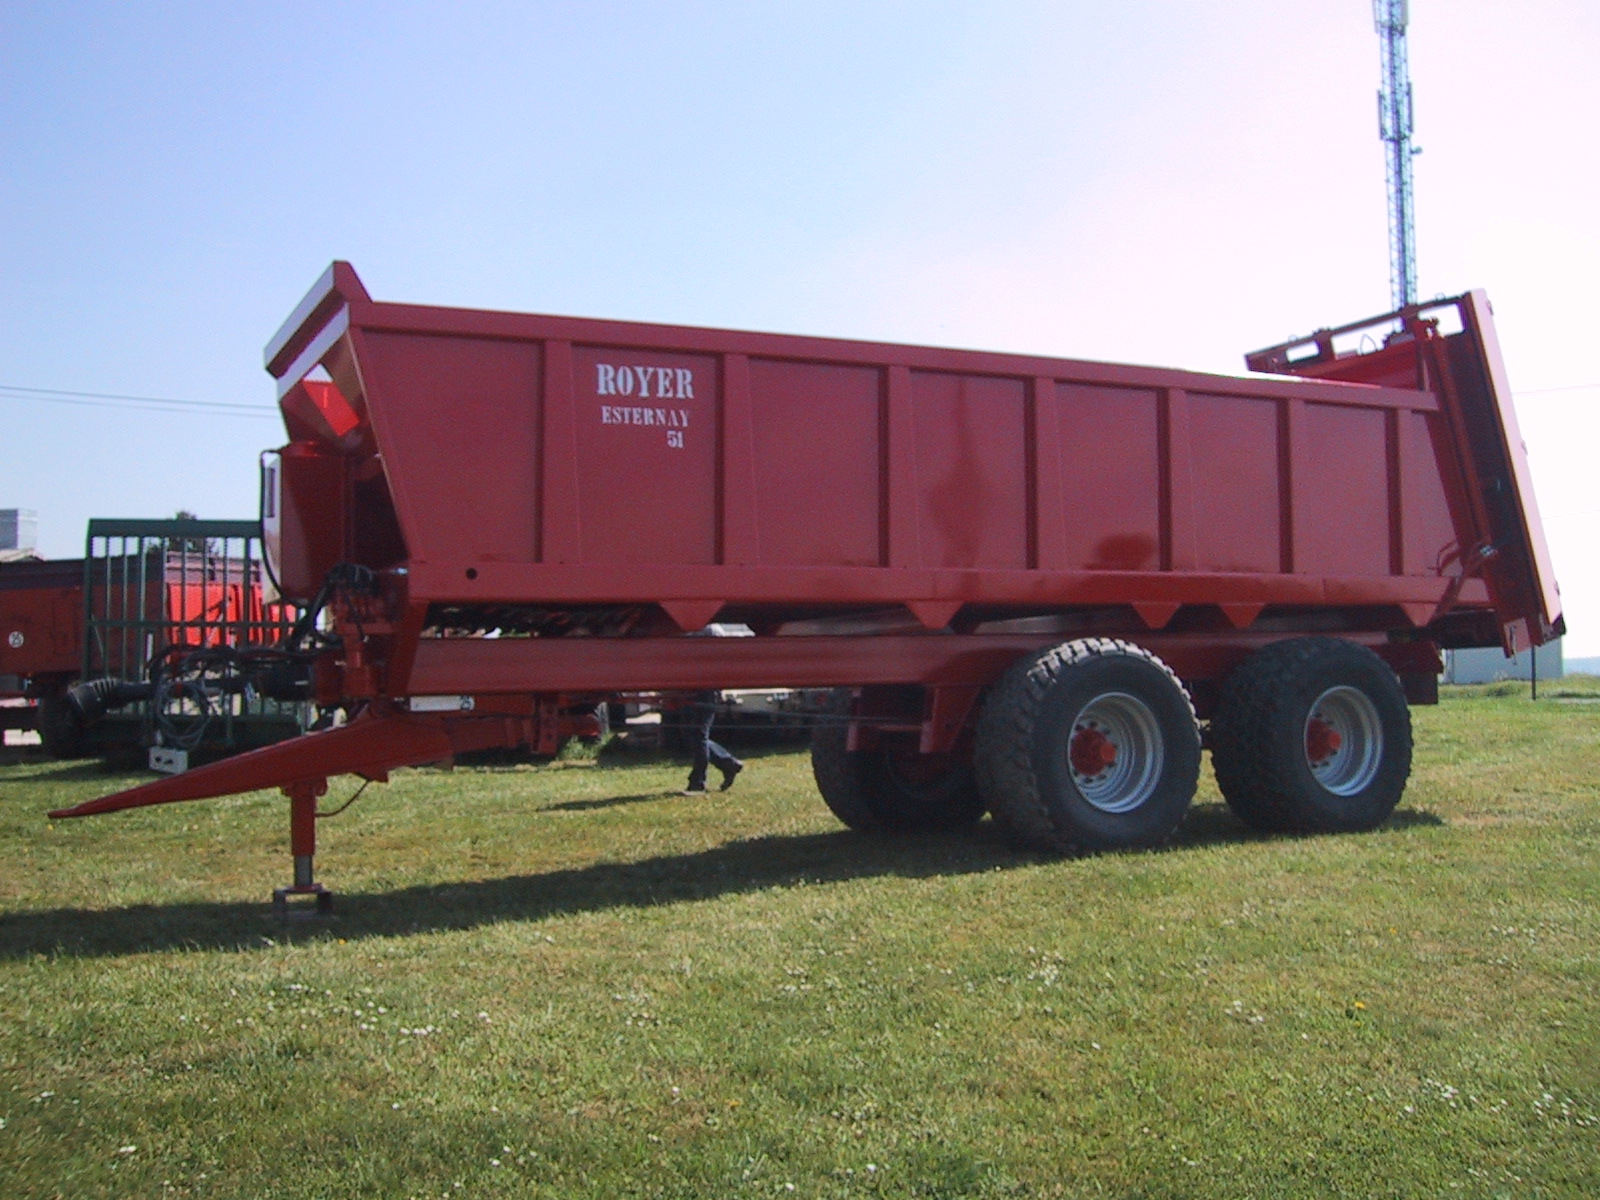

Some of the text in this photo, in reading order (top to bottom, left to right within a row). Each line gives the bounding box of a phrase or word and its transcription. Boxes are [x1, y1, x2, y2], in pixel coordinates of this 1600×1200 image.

[596, 363, 694, 399] ROYER
[602, 405, 689, 427] ESTERNAY
[666, 430, 684, 448] 51
